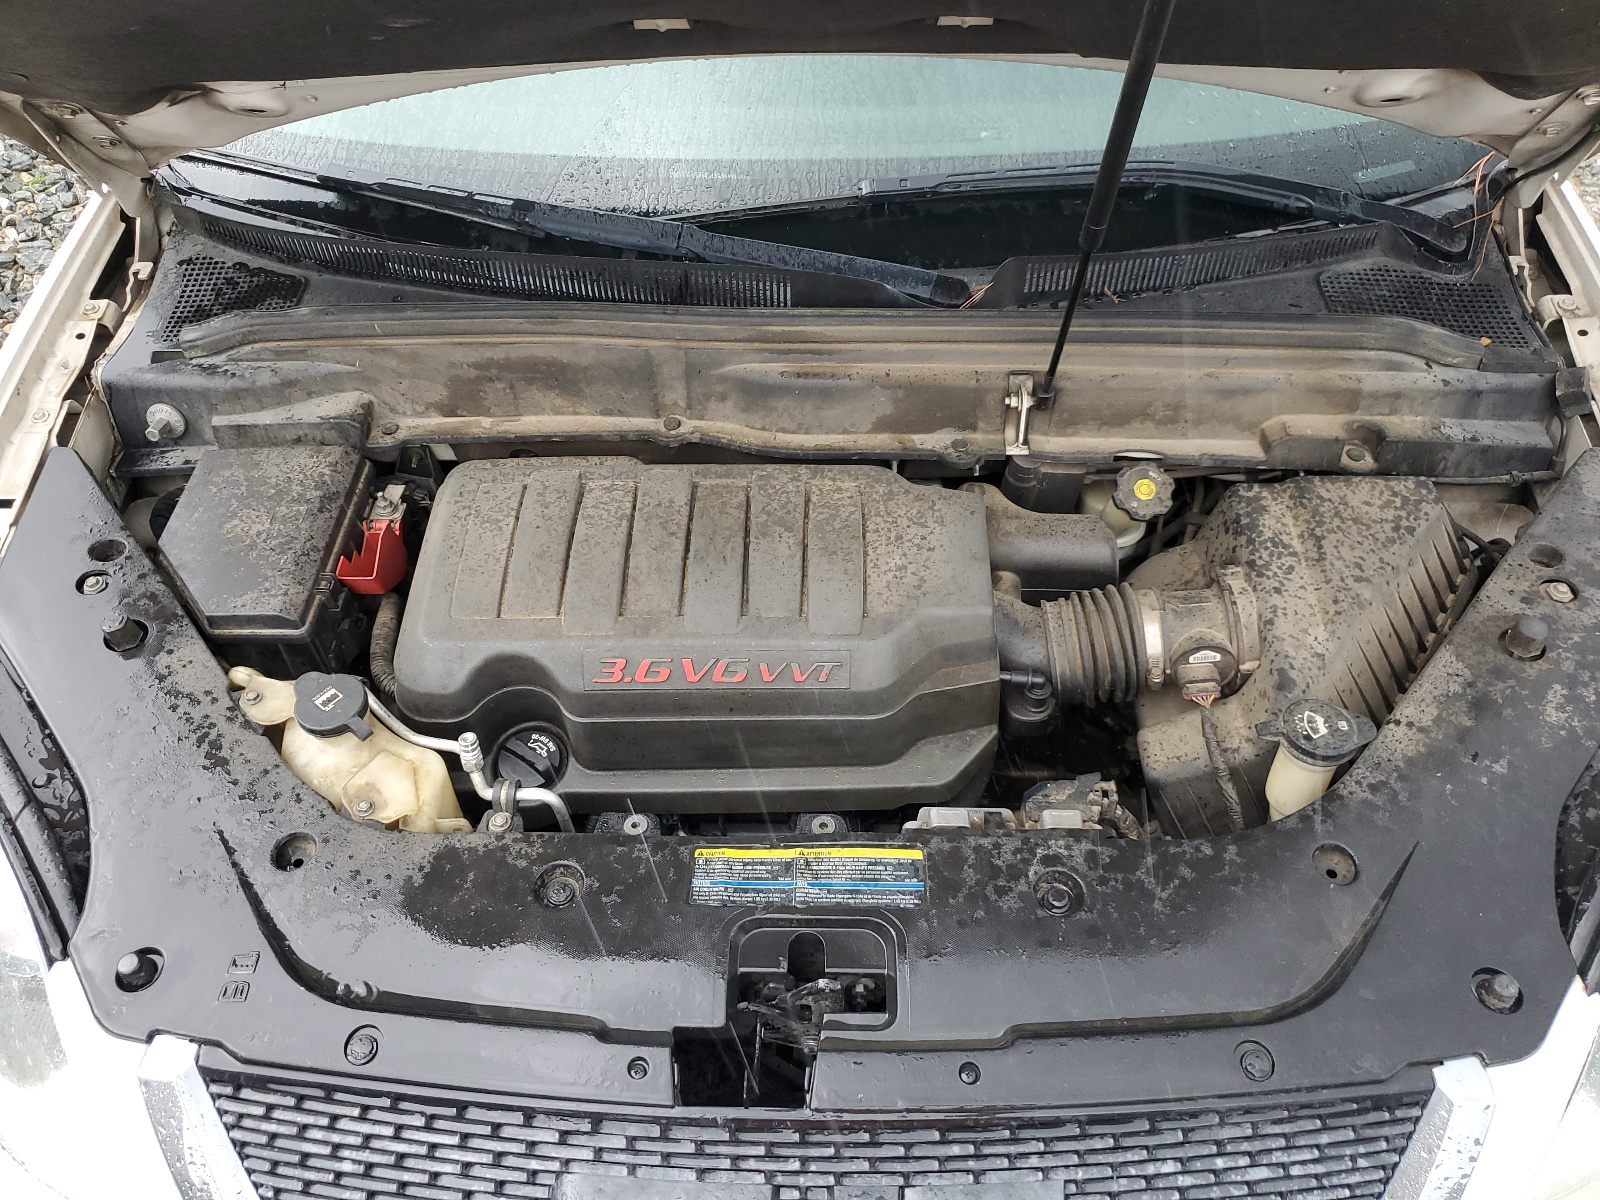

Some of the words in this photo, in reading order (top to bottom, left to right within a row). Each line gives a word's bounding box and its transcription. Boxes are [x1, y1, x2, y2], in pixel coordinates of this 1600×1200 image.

[591, 657, 673, 684] 3.6
[680, 657, 750, 684] V6
[758, 661, 842, 683] VVT
